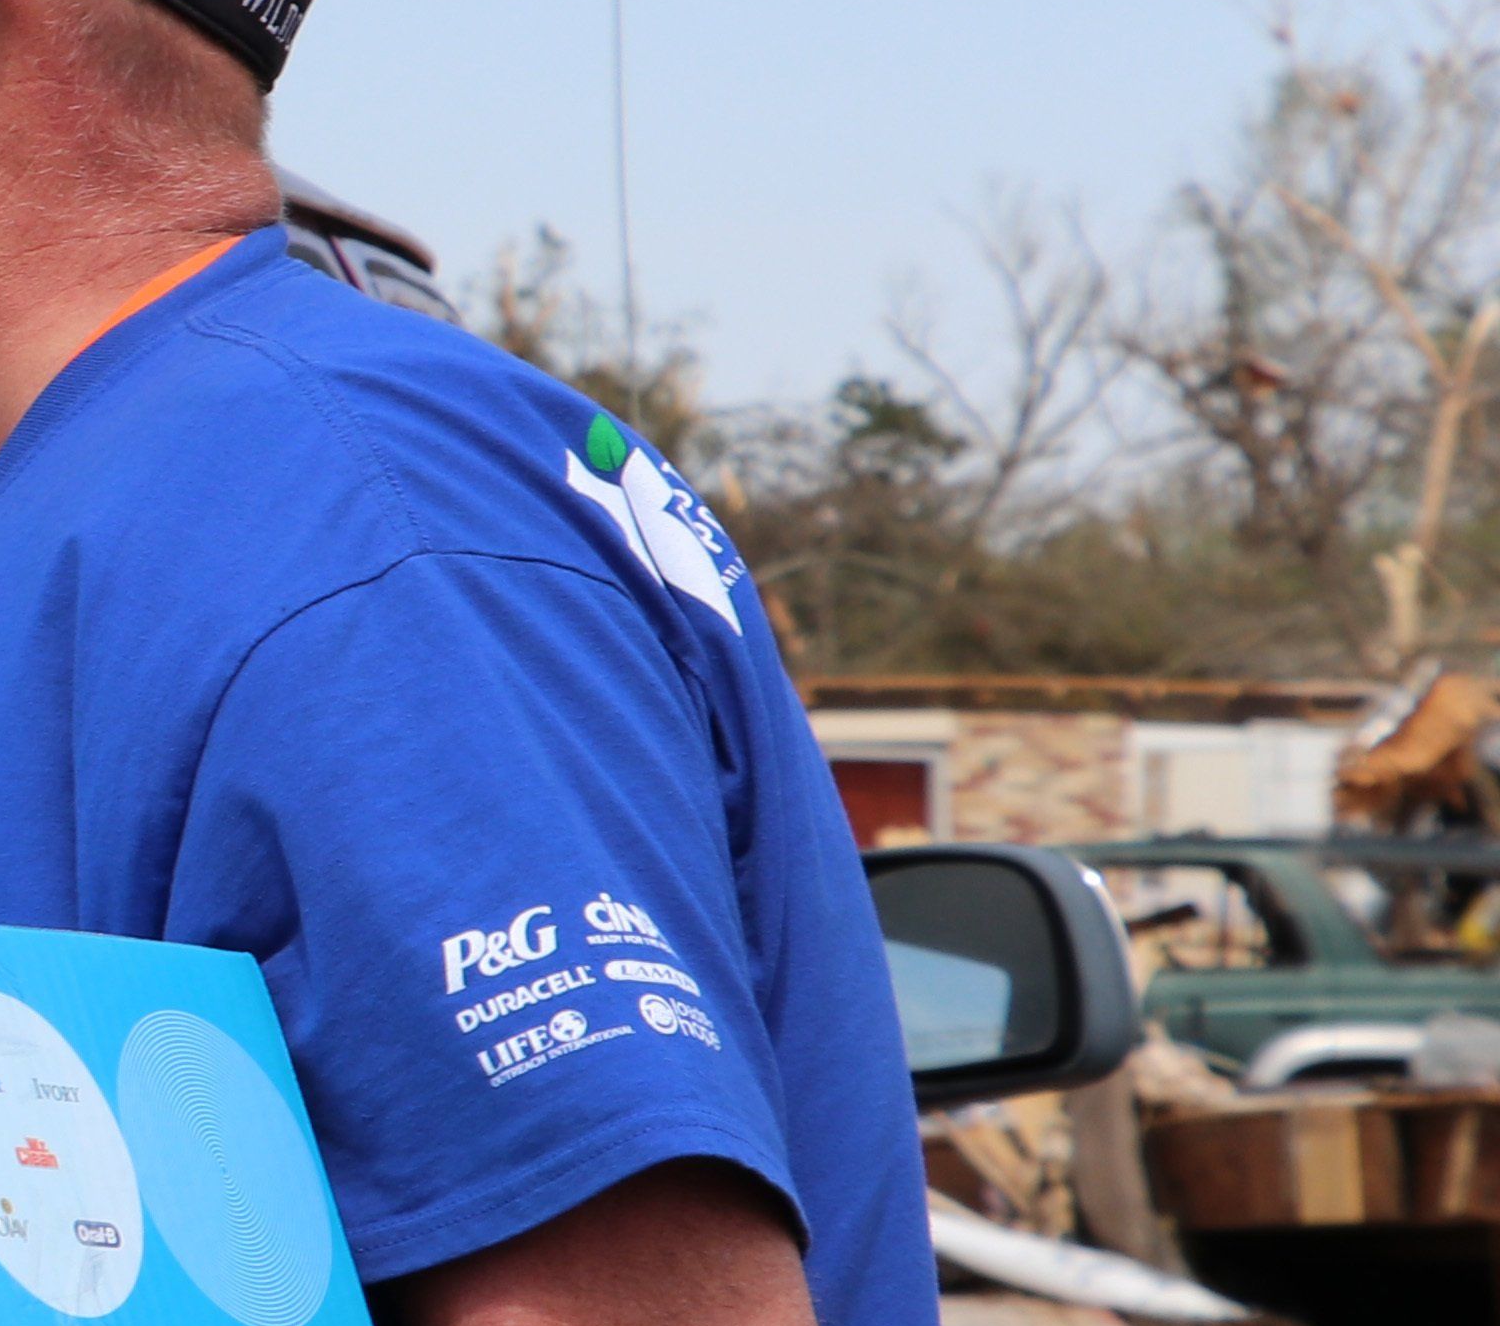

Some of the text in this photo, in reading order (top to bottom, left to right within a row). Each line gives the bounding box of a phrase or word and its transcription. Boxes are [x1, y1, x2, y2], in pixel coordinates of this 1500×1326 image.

[441, 905, 557, 994] P&G
[455, 965, 597, 1033] DURACELL
[477, 1025, 554, 1076] LIFE
[77, 1224, 118, 1244] Oral-B
